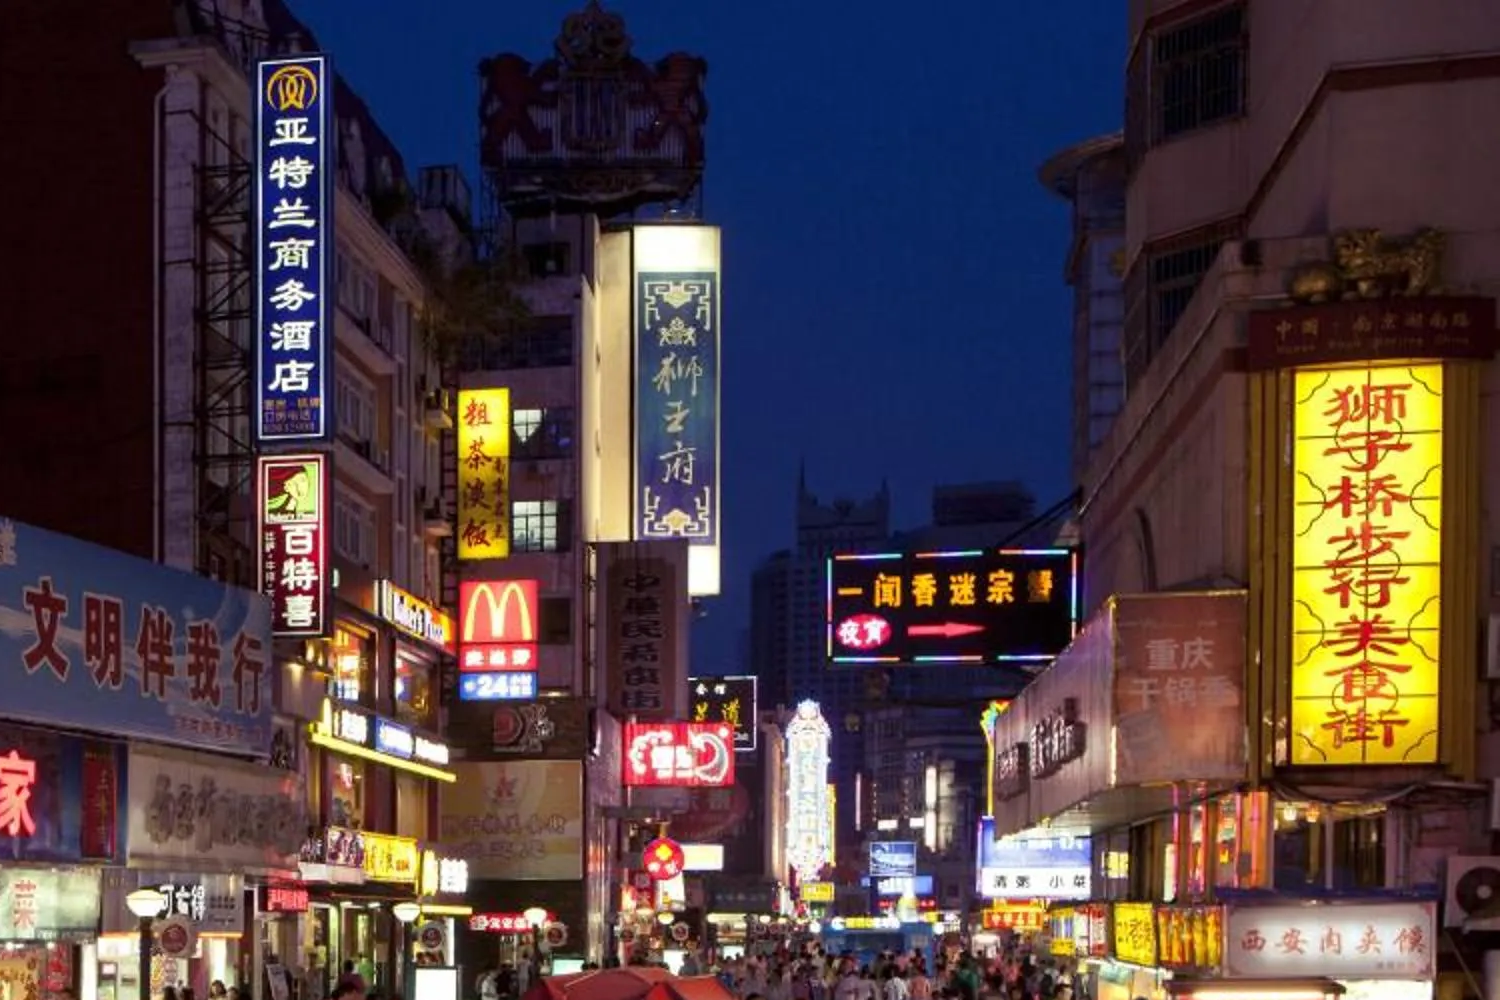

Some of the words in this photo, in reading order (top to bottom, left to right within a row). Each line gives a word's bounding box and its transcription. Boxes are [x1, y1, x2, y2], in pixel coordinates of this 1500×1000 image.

[268, 117, 317, 394] 亚特兰商务酒店
[653, 352, 704, 487] 狮王府
[280, 523, 319, 628] 百特喜
[839, 618, 888, 646] 夜宵
[1323, 383, 1413, 749] 狮子桥步行美食街
[21, 576, 264, 717] 文明伴我行
[1145, 637, 1215, 670] 重庆
